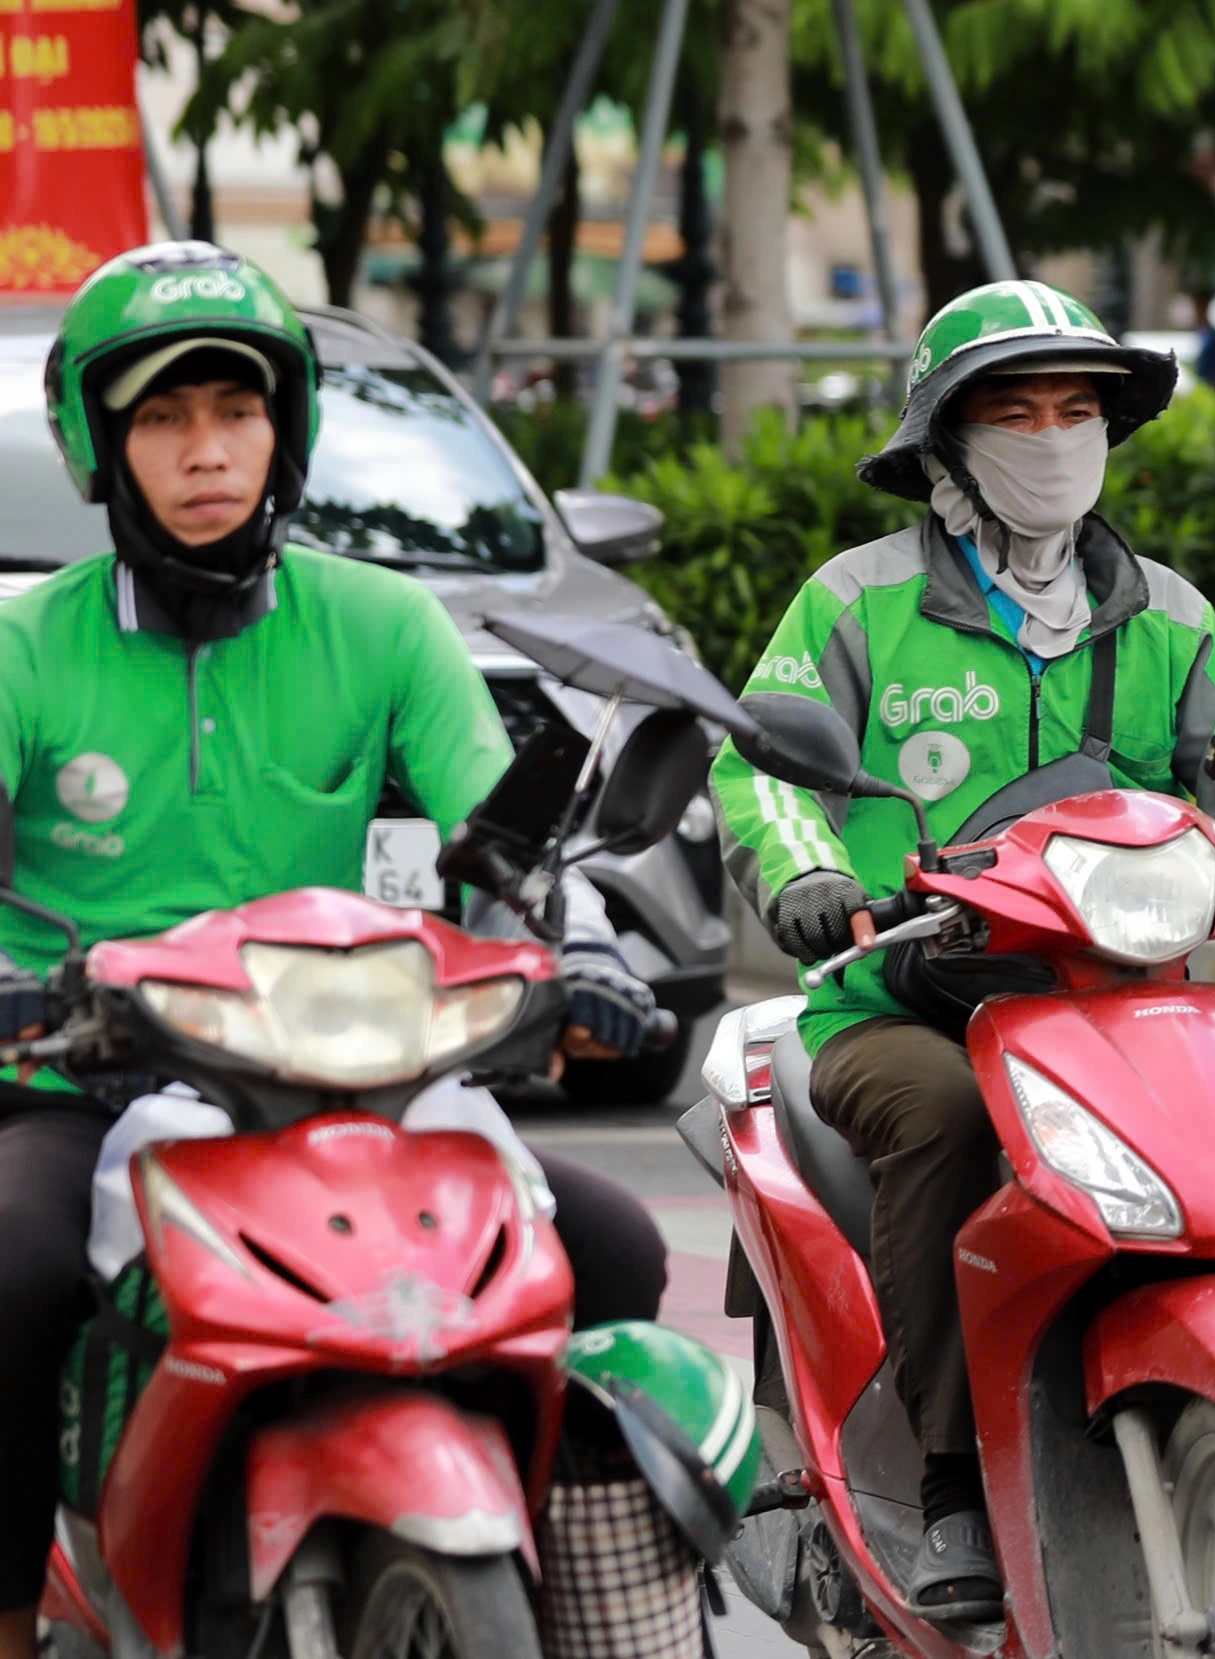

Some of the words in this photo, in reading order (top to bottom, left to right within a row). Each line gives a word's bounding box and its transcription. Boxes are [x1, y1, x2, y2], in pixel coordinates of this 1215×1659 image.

[150, 270, 245, 303] Grab
[881, 671, 999, 727] Grab
[1133, 1005, 1202, 1018] HONDA
[958, 1247, 998, 1273] HONDA
